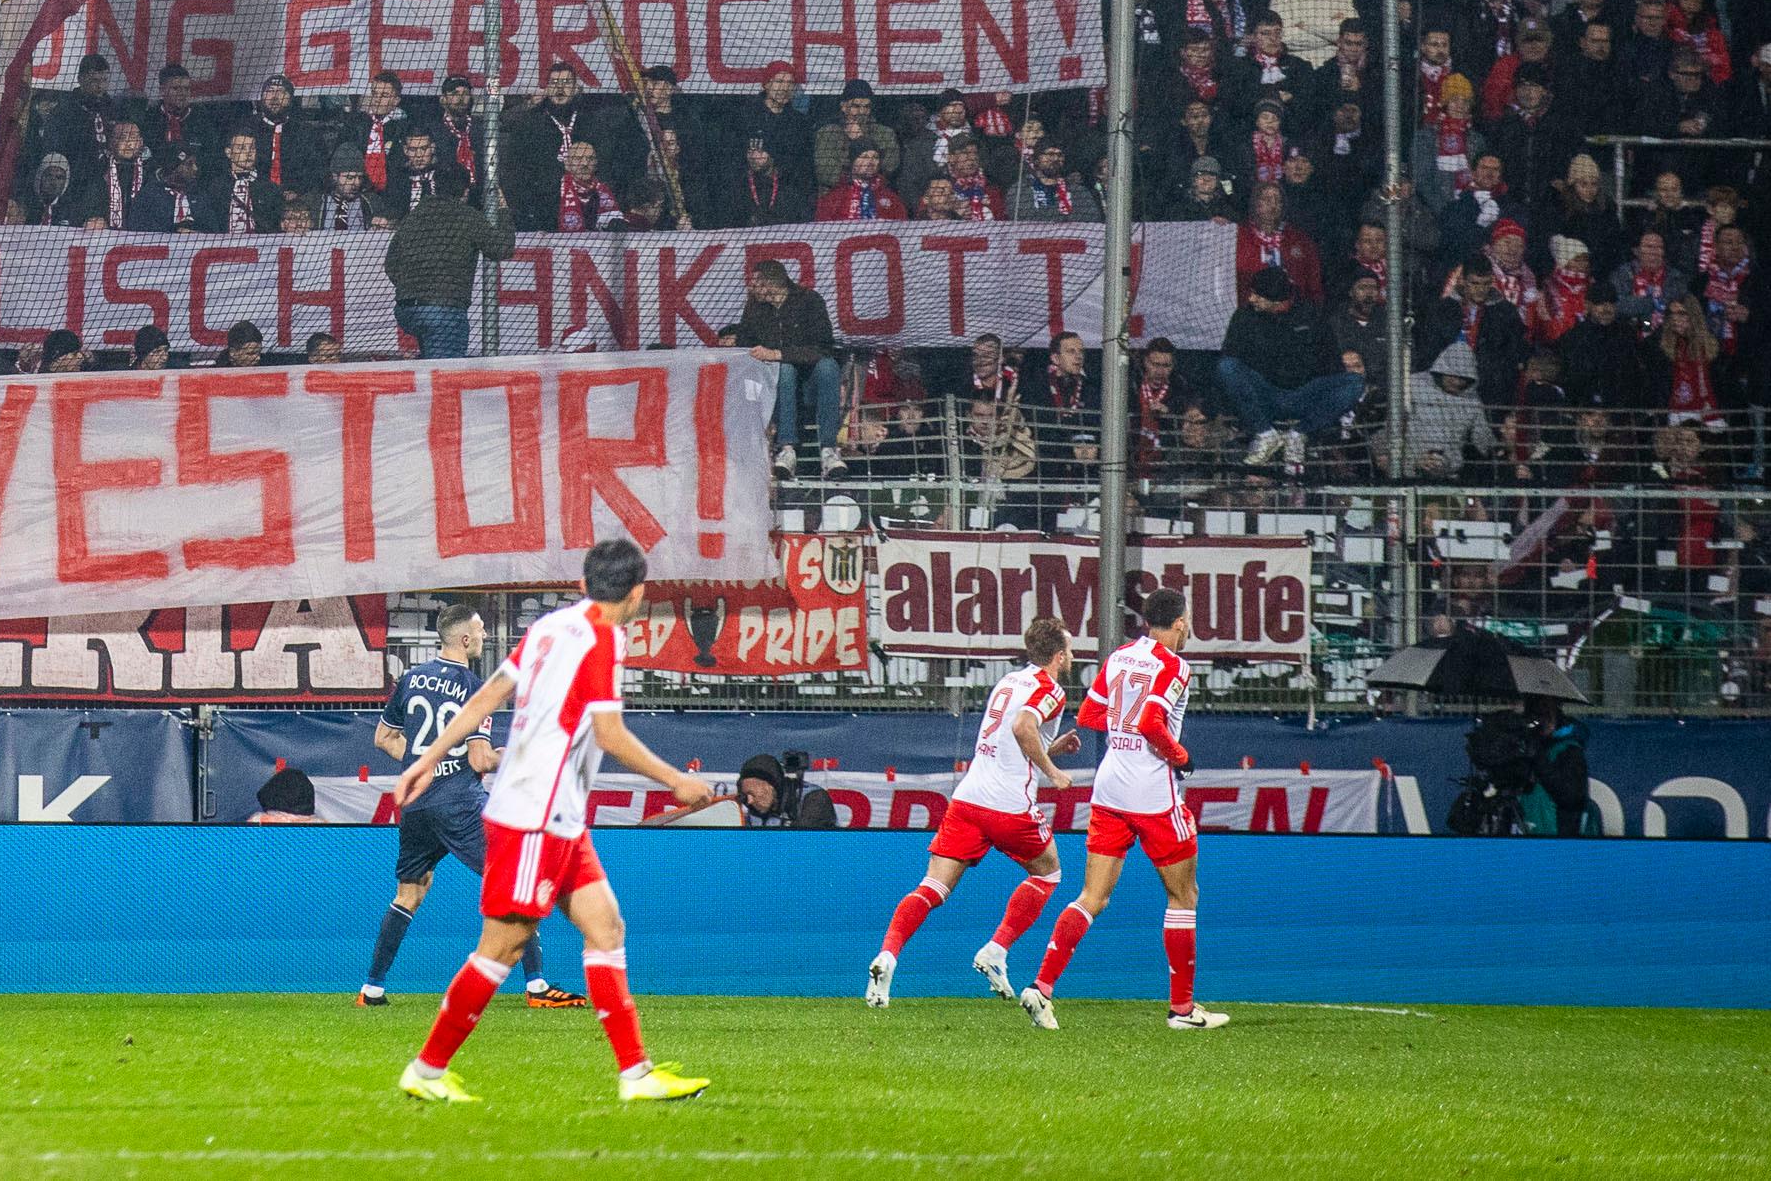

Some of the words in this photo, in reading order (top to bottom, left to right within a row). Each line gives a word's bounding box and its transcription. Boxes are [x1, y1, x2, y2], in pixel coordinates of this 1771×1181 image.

[397, 231, 1145, 353] ANKOTT!
[625, 600, 677, 658] ED
[736, 606, 862, 666] PRIDE
[409, 674, 468, 702] BOCHUM
[982, 687, 1014, 740] 9
[1110, 736, 1143, 752] SIALA
[431, 759, 461, 779] DETS
